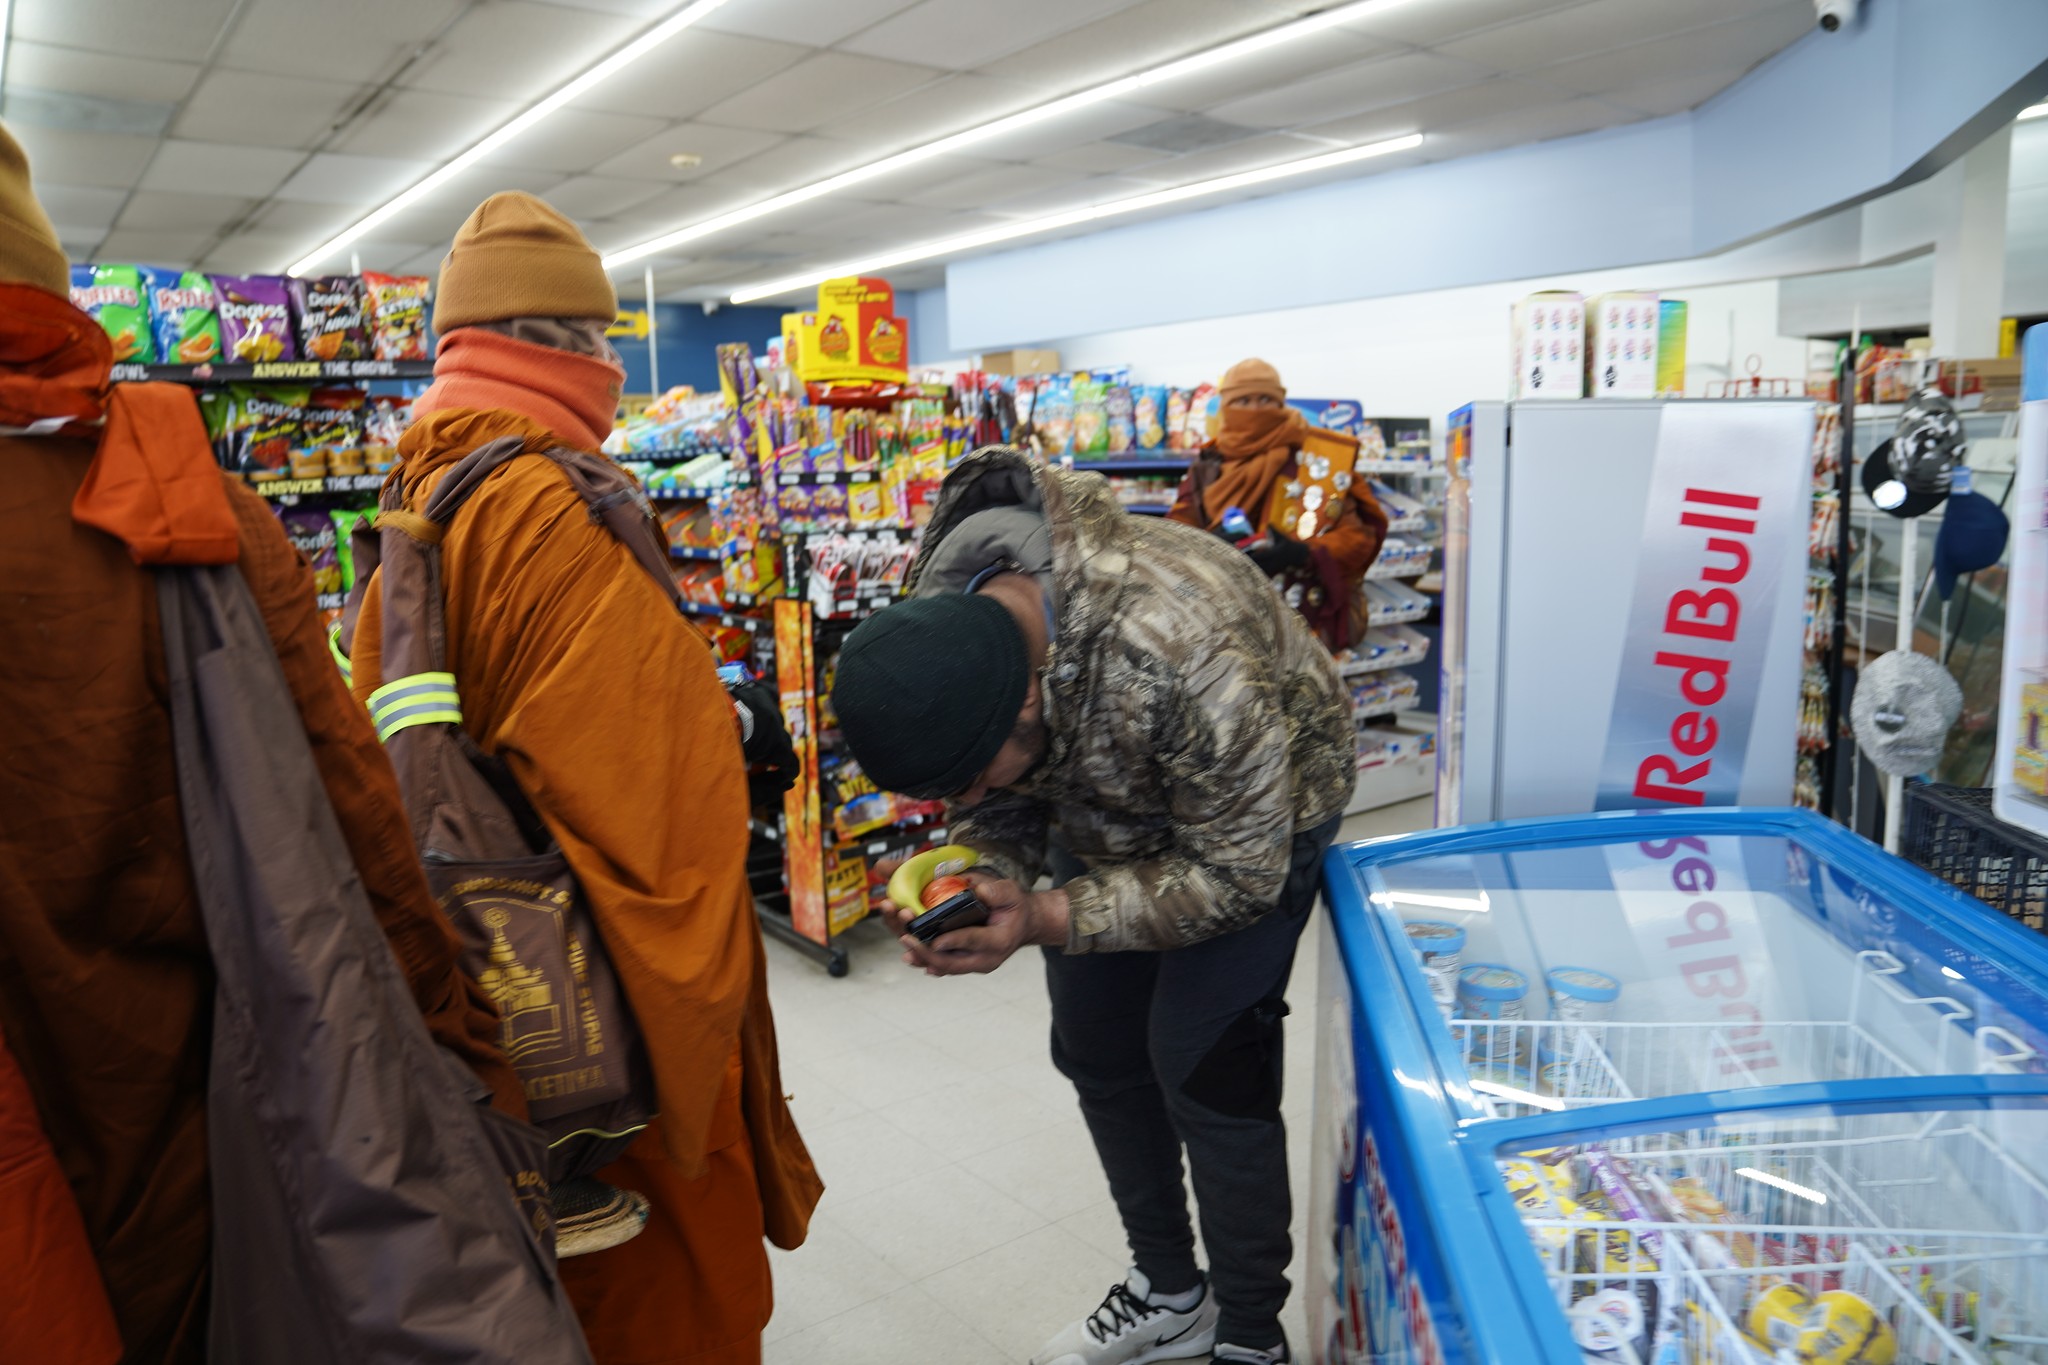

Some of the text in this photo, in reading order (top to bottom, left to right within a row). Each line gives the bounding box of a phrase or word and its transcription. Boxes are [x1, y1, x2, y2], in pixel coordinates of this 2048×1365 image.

[220, 302, 288, 322] Doritos
[110, 363, 149, 380] OWL
[252, 360, 397, 378] ANSWER THE GROWL
[246, 398, 302, 419] Doritos
[257, 478, 323, 496] ANSWER
[326, 476, 351, 490] THE
[1632, 486, 1762, 807] Red Bull
